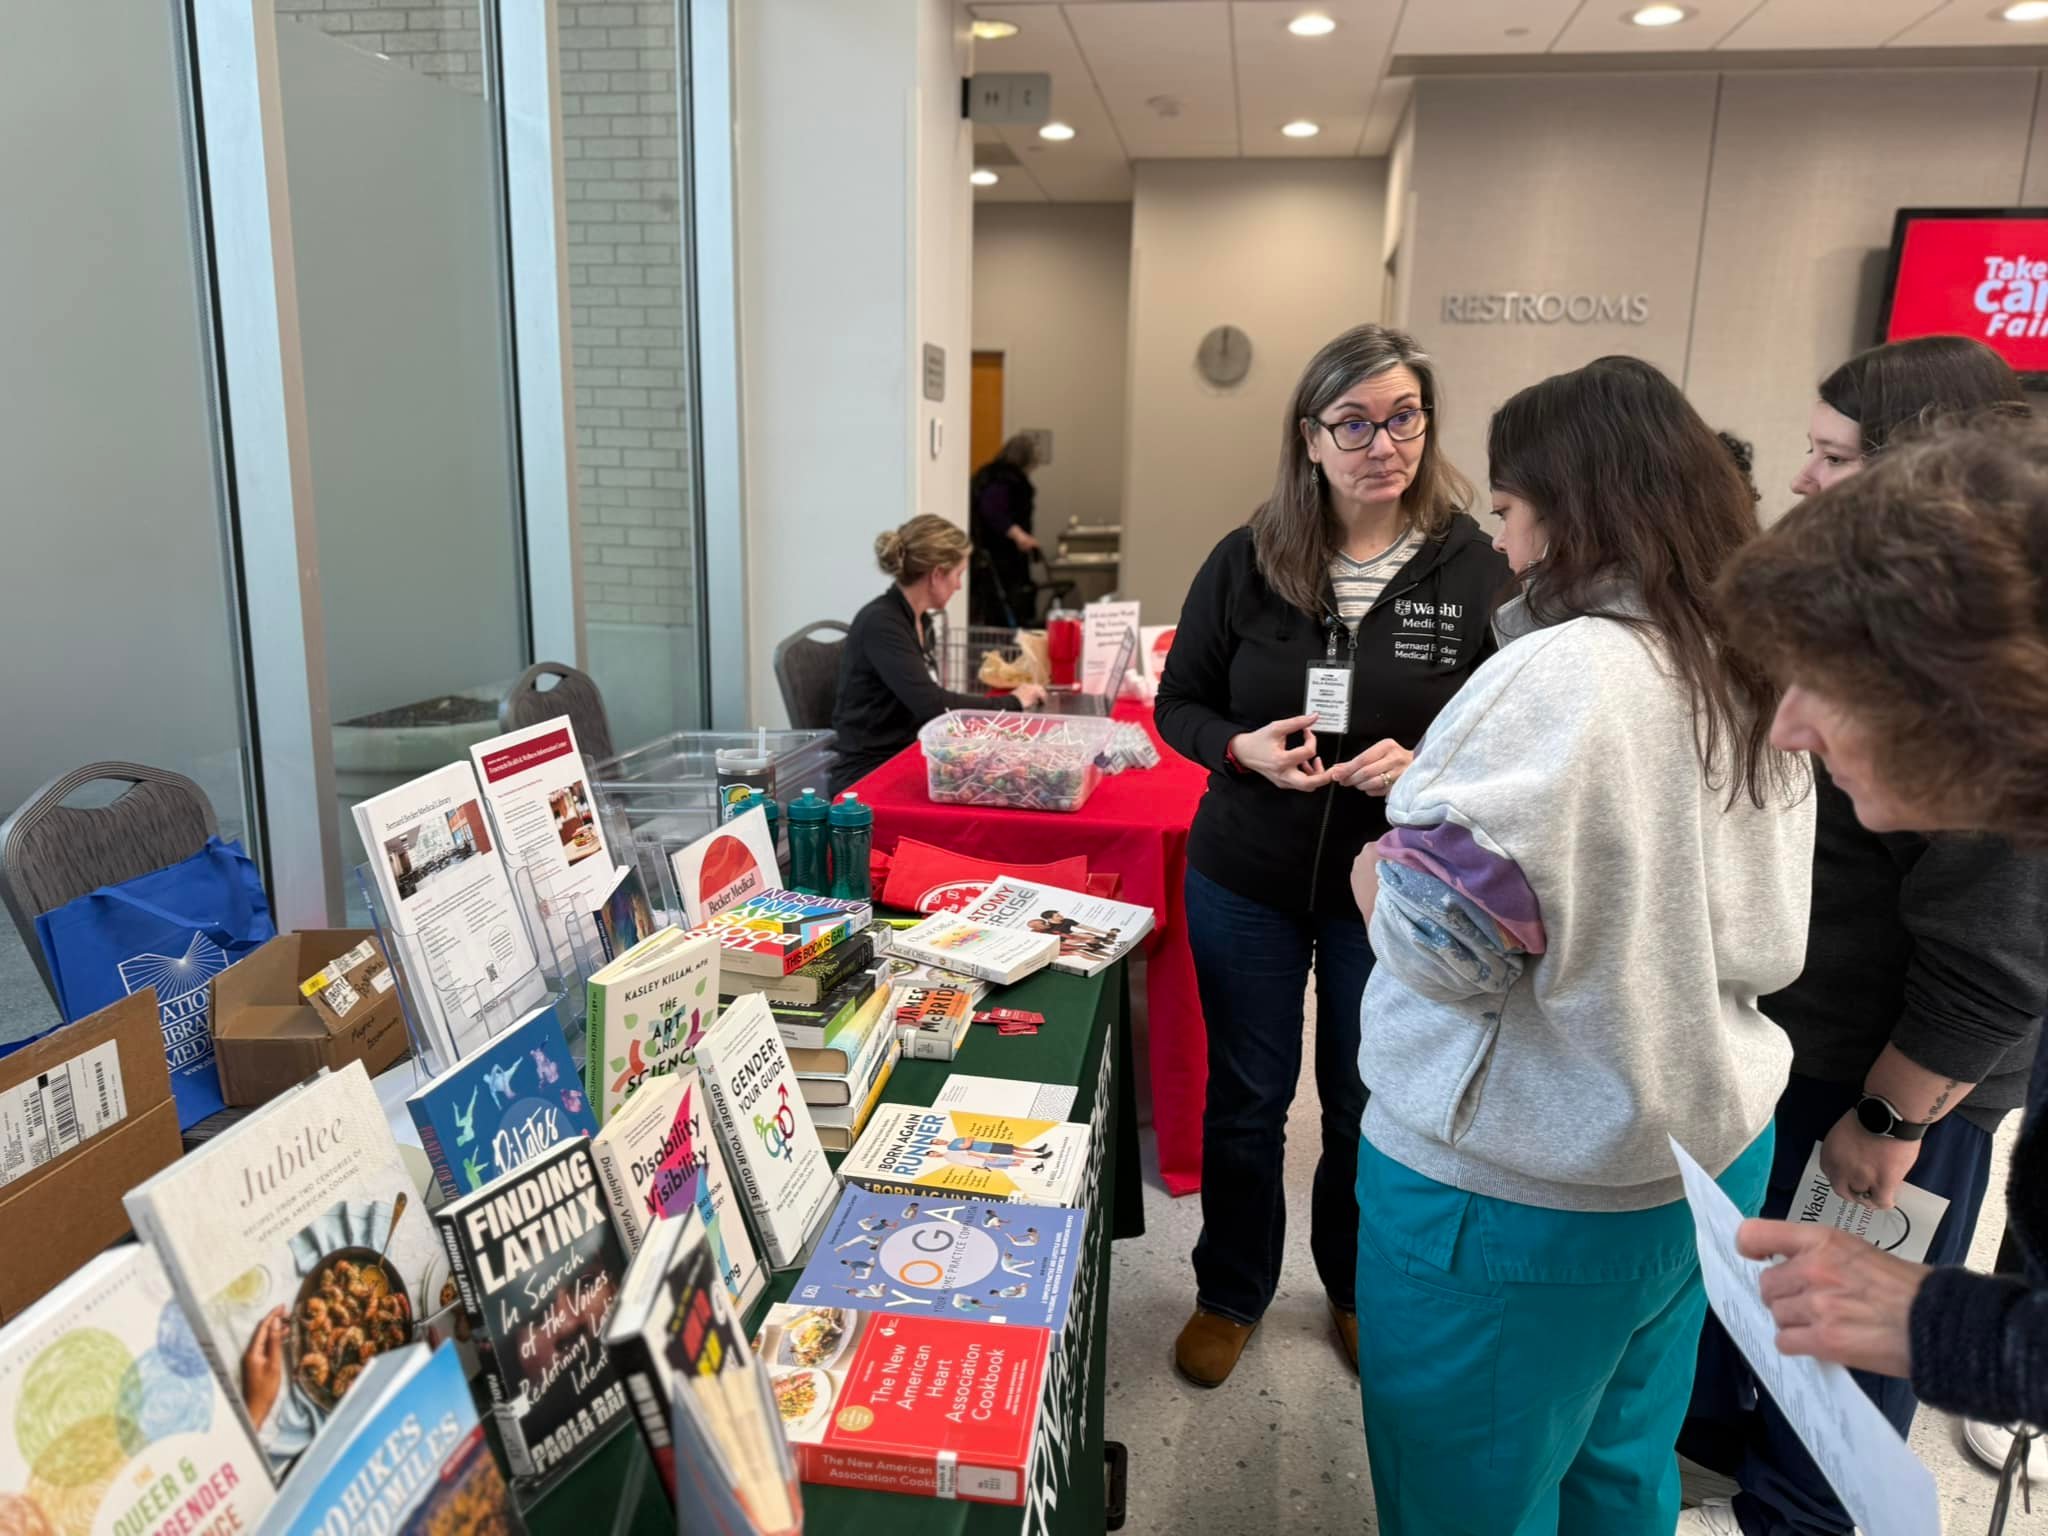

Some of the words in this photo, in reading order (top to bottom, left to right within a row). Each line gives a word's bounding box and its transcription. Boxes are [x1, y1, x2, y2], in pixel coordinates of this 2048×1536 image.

[1984, 255, 2048, 280] Take
[1442, 292, 1649, 325] RESTROOMS
[708, 892, 731, 916] Becker
[730, 872, 756, 899] Medical
[747, 896, 811, 914] JUNO
[763, 887, 871, 913] DAWSON
[786, 953, 803, 971] THIS
[803, 941, 824, 961] BOOK
[822, 935, 831, 949] IS
[831, 928, 846, 944] GAY
[624, 980, 661, 1002] KASLEY
[662, 965, 693, 986] KILLAM,
[659, 997, 678, 1014] THE
[905, 988, 930, 1024] JAMES
[920, 983, 959, 1033] McBRIDE
[652, 1011, 683, 1041] ART
[655, 1038, 677, 1056] AND
[731, 1035, 778, 1098] GENDER:
[738, 1078, 765, 1116] YOUR
[760, 1055, 787, 1091] GUIDE
[240, 1118, 343, 1208] Jubilee
[492, 1106, 559, 1177] Pilates
[630, 1113, 701, 1188] Disability
[729, 1134, 749, 1166] YOUR
[740, 1164, 761, 1206] GUIDE
[879, 1141, 903, 1171] BORN
[898, 1113, 923, 1144] AGAIN
[892, 1114, 947, 1177] RUNNER
[465, 1150, 594, 1251] FINDING
[600, 1156, 625, 1208] Disability
[644, 1145, 709, 1214] Visibility
[442, 1224, 465, 1274] FINDING
[456, 1271, 478, 1314] LATINX
[476, 1185, 606, 1295] LATINX
[885, 1205, 966, 1308] YOGA
[946, 1239, 966, 1274] PRACTICE
[957, 1202, 978, 1240] COMPANION
[500, 1299, 520, 1336] In
[524, 1246, 585, 1310] Search
[724, 1263, 741, 1286] ong
[521, 1321, 537, 1358] of
[541, 1303, 567, 1338] the
[566, 1269, 610, 1317] Voices
[518, 1334, 590, 1405] Redefining
[870, 1376, 897, 1405] The
[882, 1344, 908, 1375] New
[896, 1344, 933, 1411] American
[924, 1358, 953, 1398] Heart
[945, 1343, 983, 1424] Association
[970, 1348, 1006, 1421] Cookbook
[530, 1408, 596, 1474] PAOLA
[822, 1454, 844, 1467] The
[848, 1457, 874, 1470] New
[877, 1460, 933, 1475] American
[112, 1472, 180, 1536] QUEER
[178, 1456, 198, 1484] &
[153, 1462, 240, 1536] GENDER
[830, 1468, 897, 1484] Association
